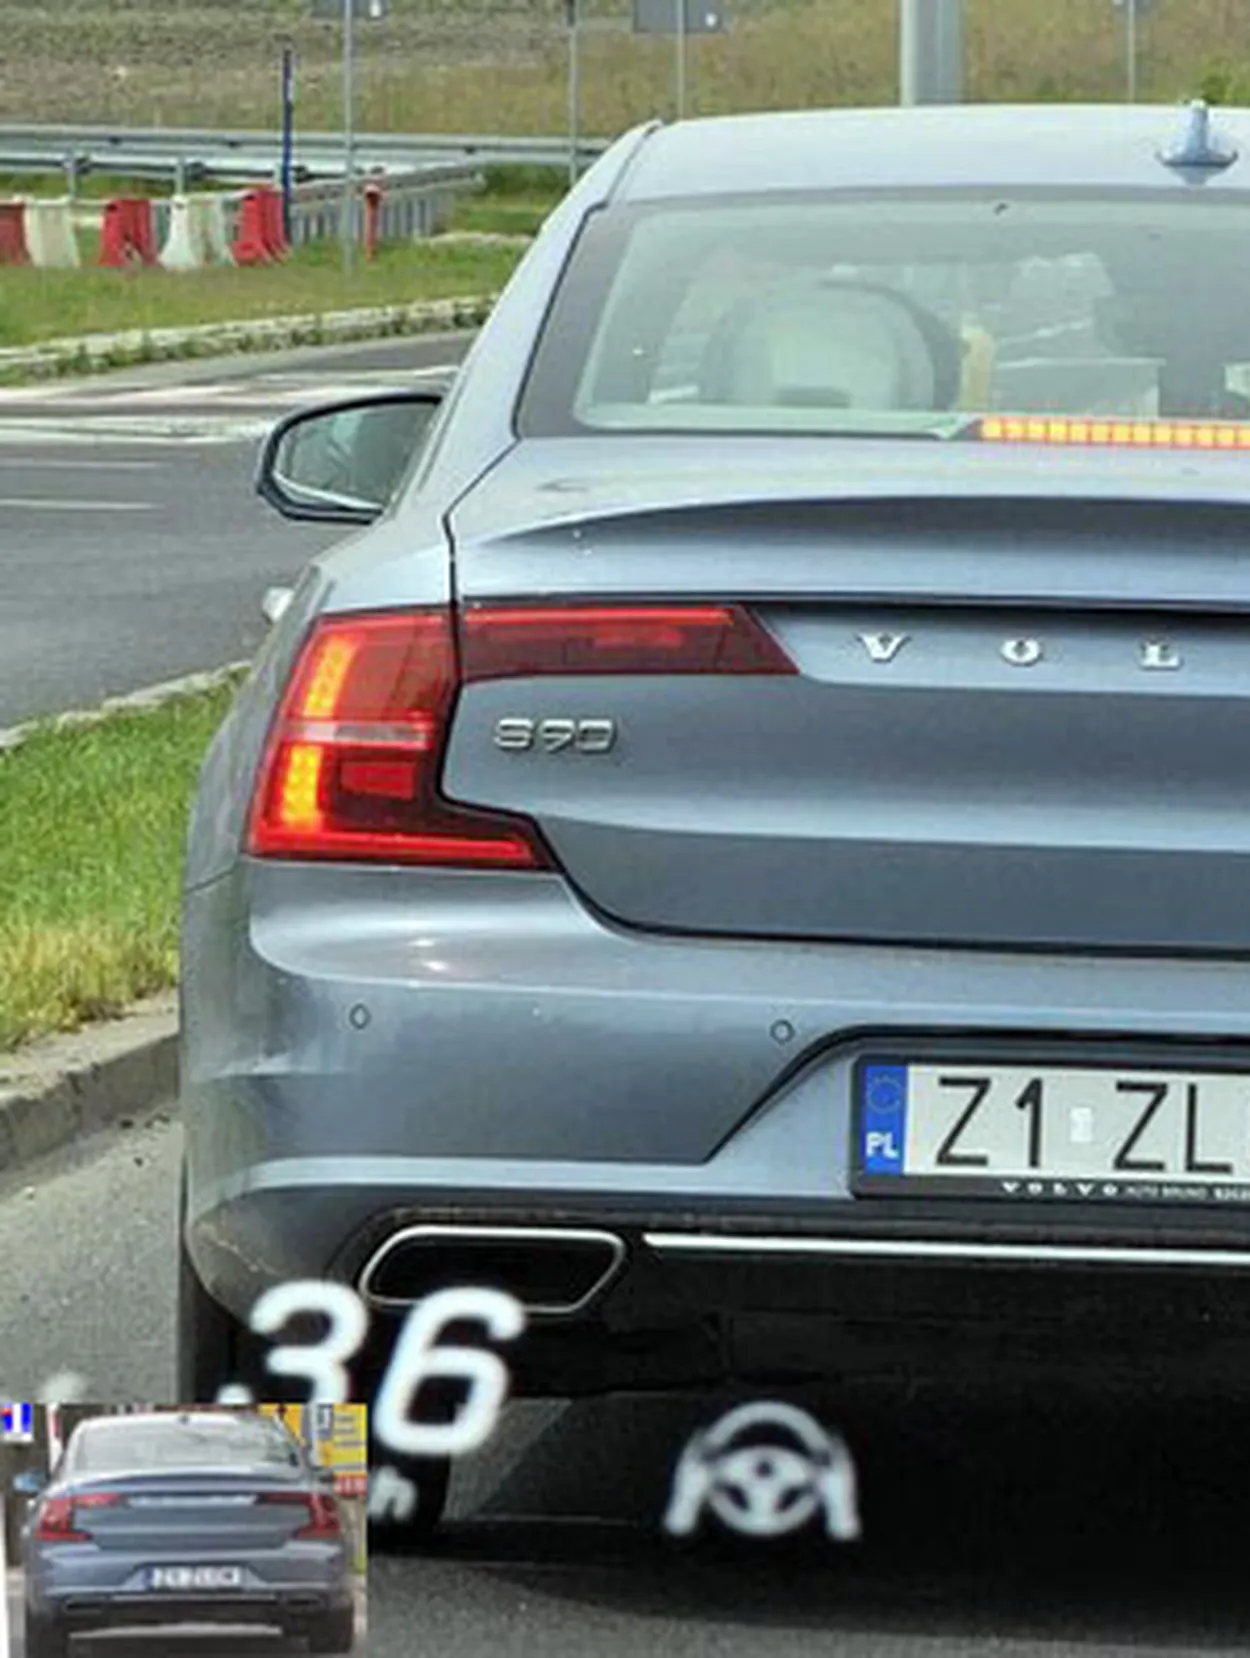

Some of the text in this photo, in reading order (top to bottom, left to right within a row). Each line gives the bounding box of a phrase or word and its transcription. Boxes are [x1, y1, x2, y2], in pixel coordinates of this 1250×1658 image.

[494, 718, 613, 750] S90
[936, 1077, 1042, 1168] Z1
[866, 1132, 899, 1158] PL
[1001, 1181, 1119, 1197] VOLVO
[249, 1279, 526, 1456] 36
